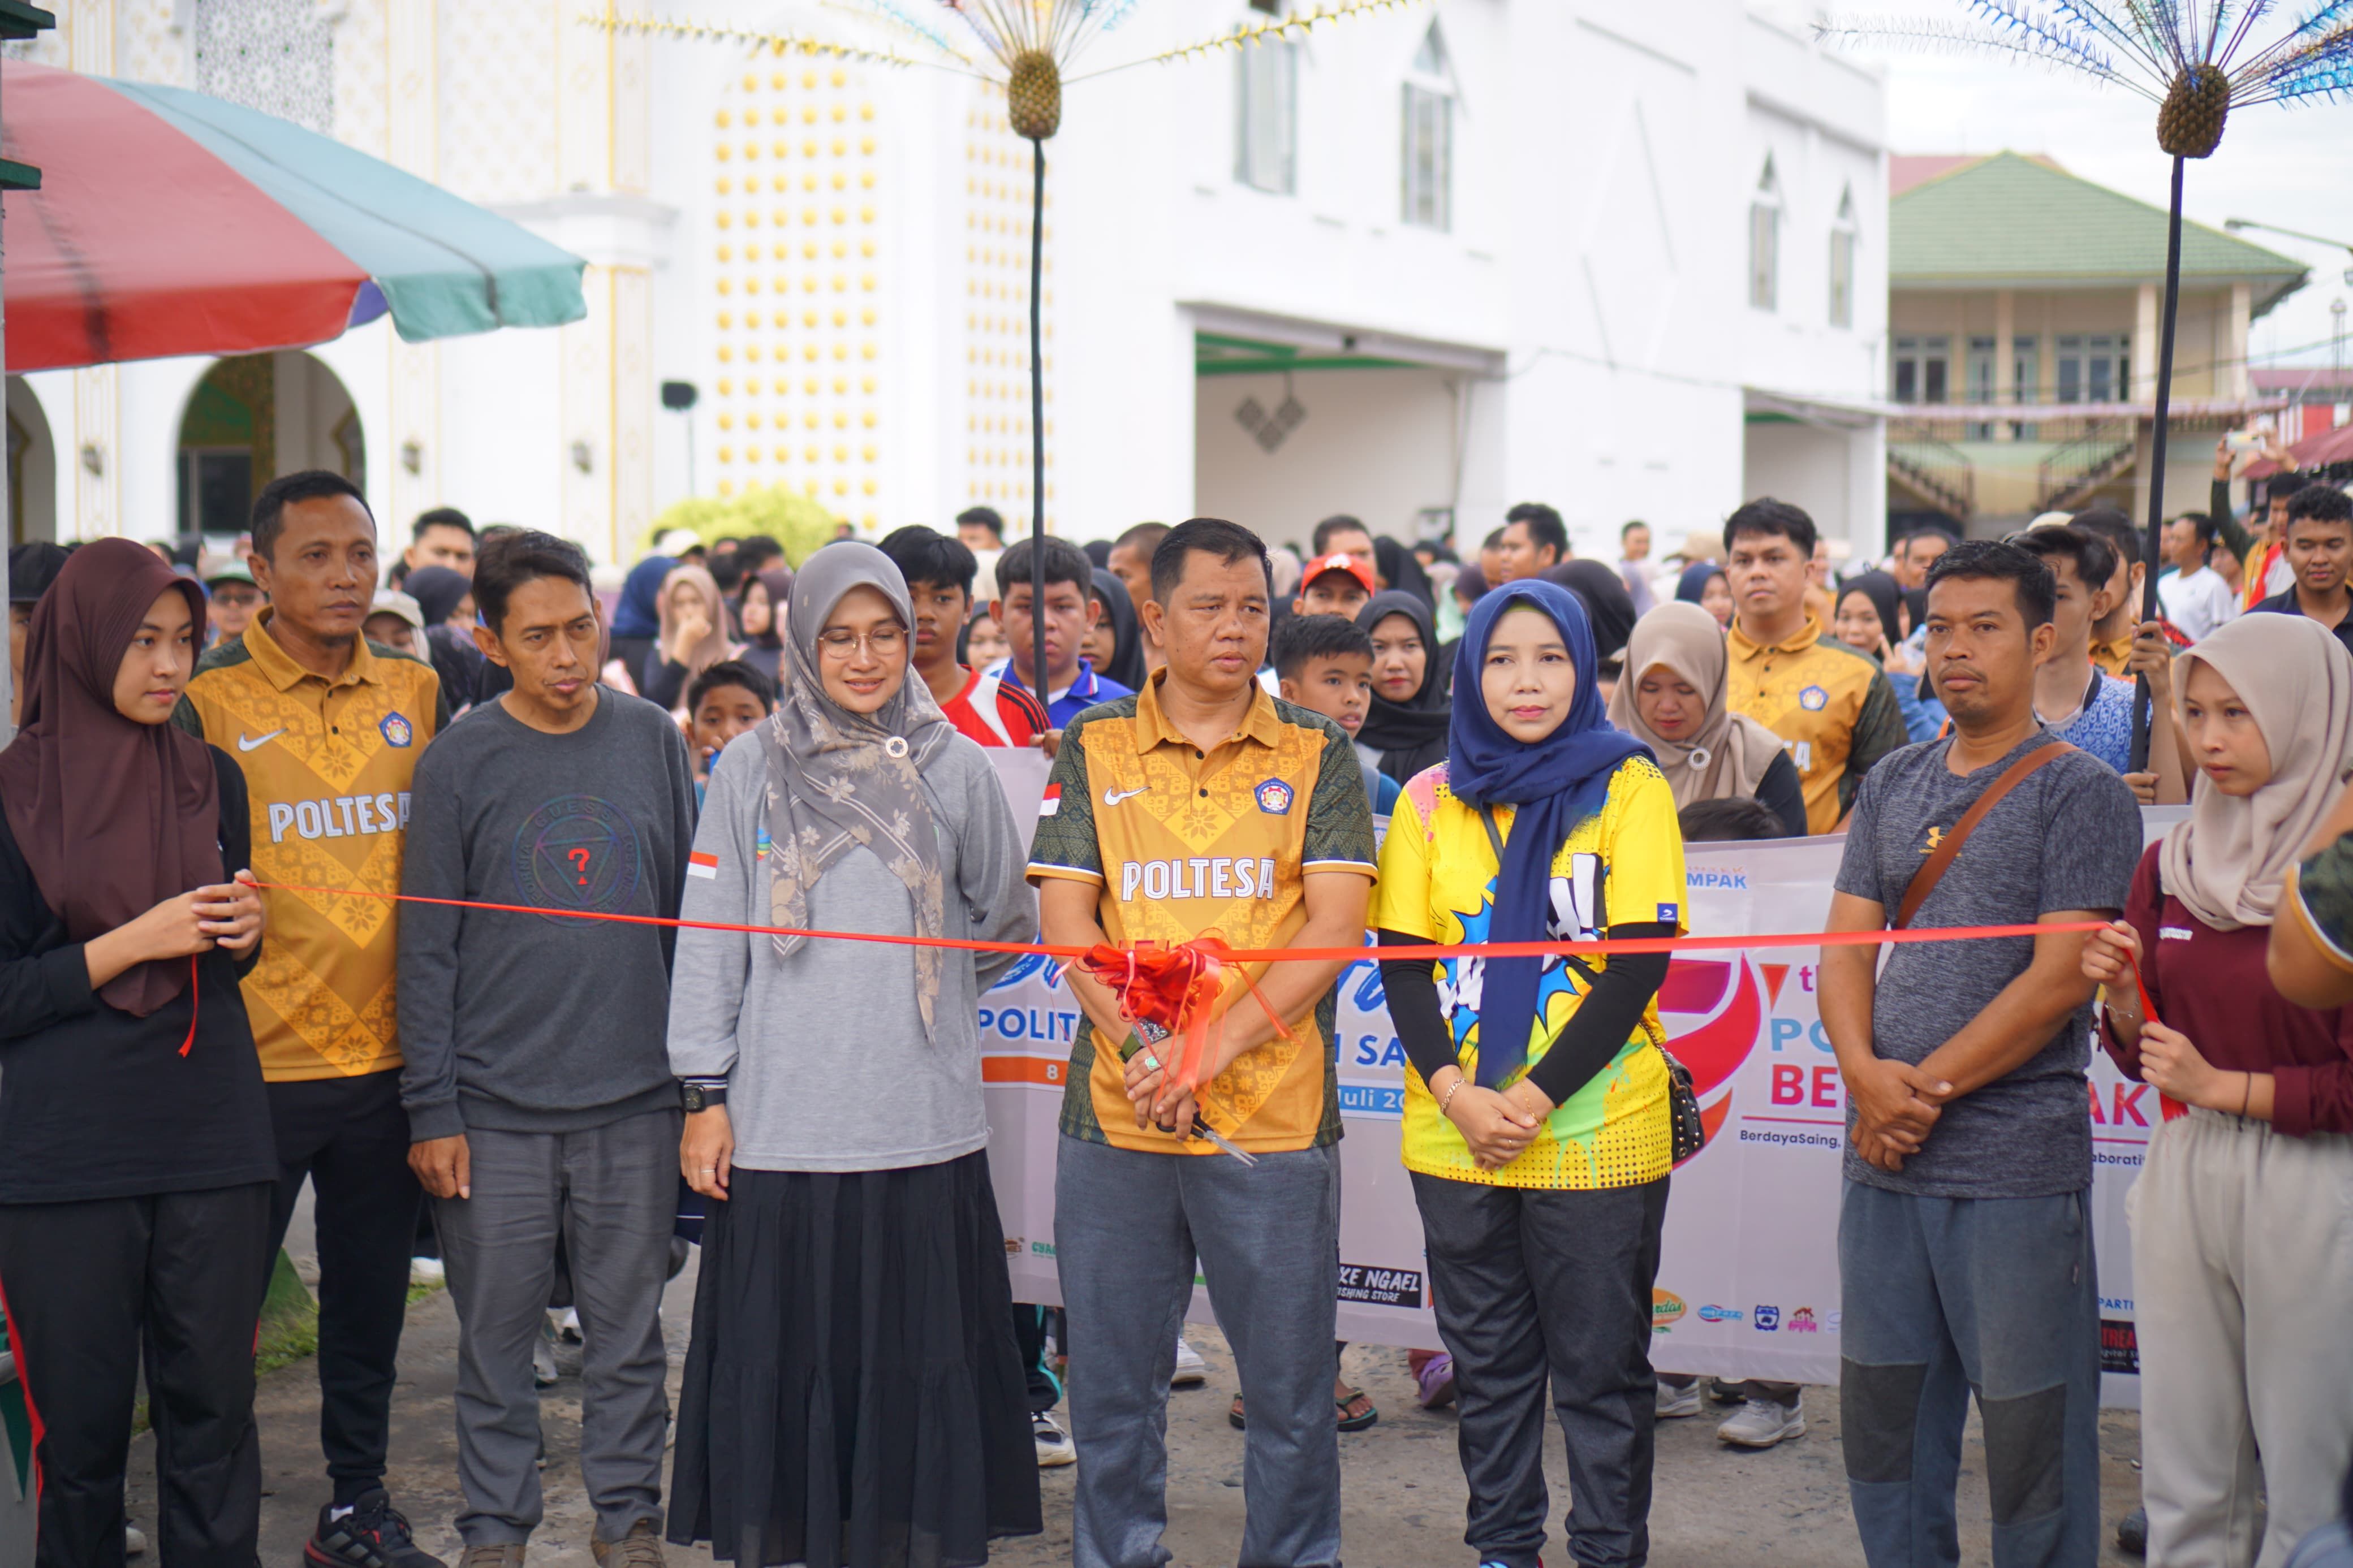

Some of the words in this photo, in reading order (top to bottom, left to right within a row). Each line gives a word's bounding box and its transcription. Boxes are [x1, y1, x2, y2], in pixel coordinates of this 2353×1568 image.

[269, 792, 412, 843] POLTESA
[534, 801, 613, 828] GUESS
[1122, 857, 1275, 901] POLTESA
[1687, 872, 1747, 889] MPAK
[1799, 965, 1819, 992] t
[979, 1008, 1076, 1042] POLIT
[1770, 1018, 1834, 1053] PO
[1356, 1035, 1406, 1066] SA
[1046, 1064, 1059, 1080] 8
[1771, 1064, 1848, 1108] BE
[2087, 1082, 2150, 1127] AK
[2093, 1152, 2146, 1166] aborati
[1339, 1266, 1361, 1286] KE
[1365, 1270, 1419, 1292] NGAEL
[1337, 1286, 1369, 1299] ISHING
[1371, 1290, 1400, 1302] STORE
